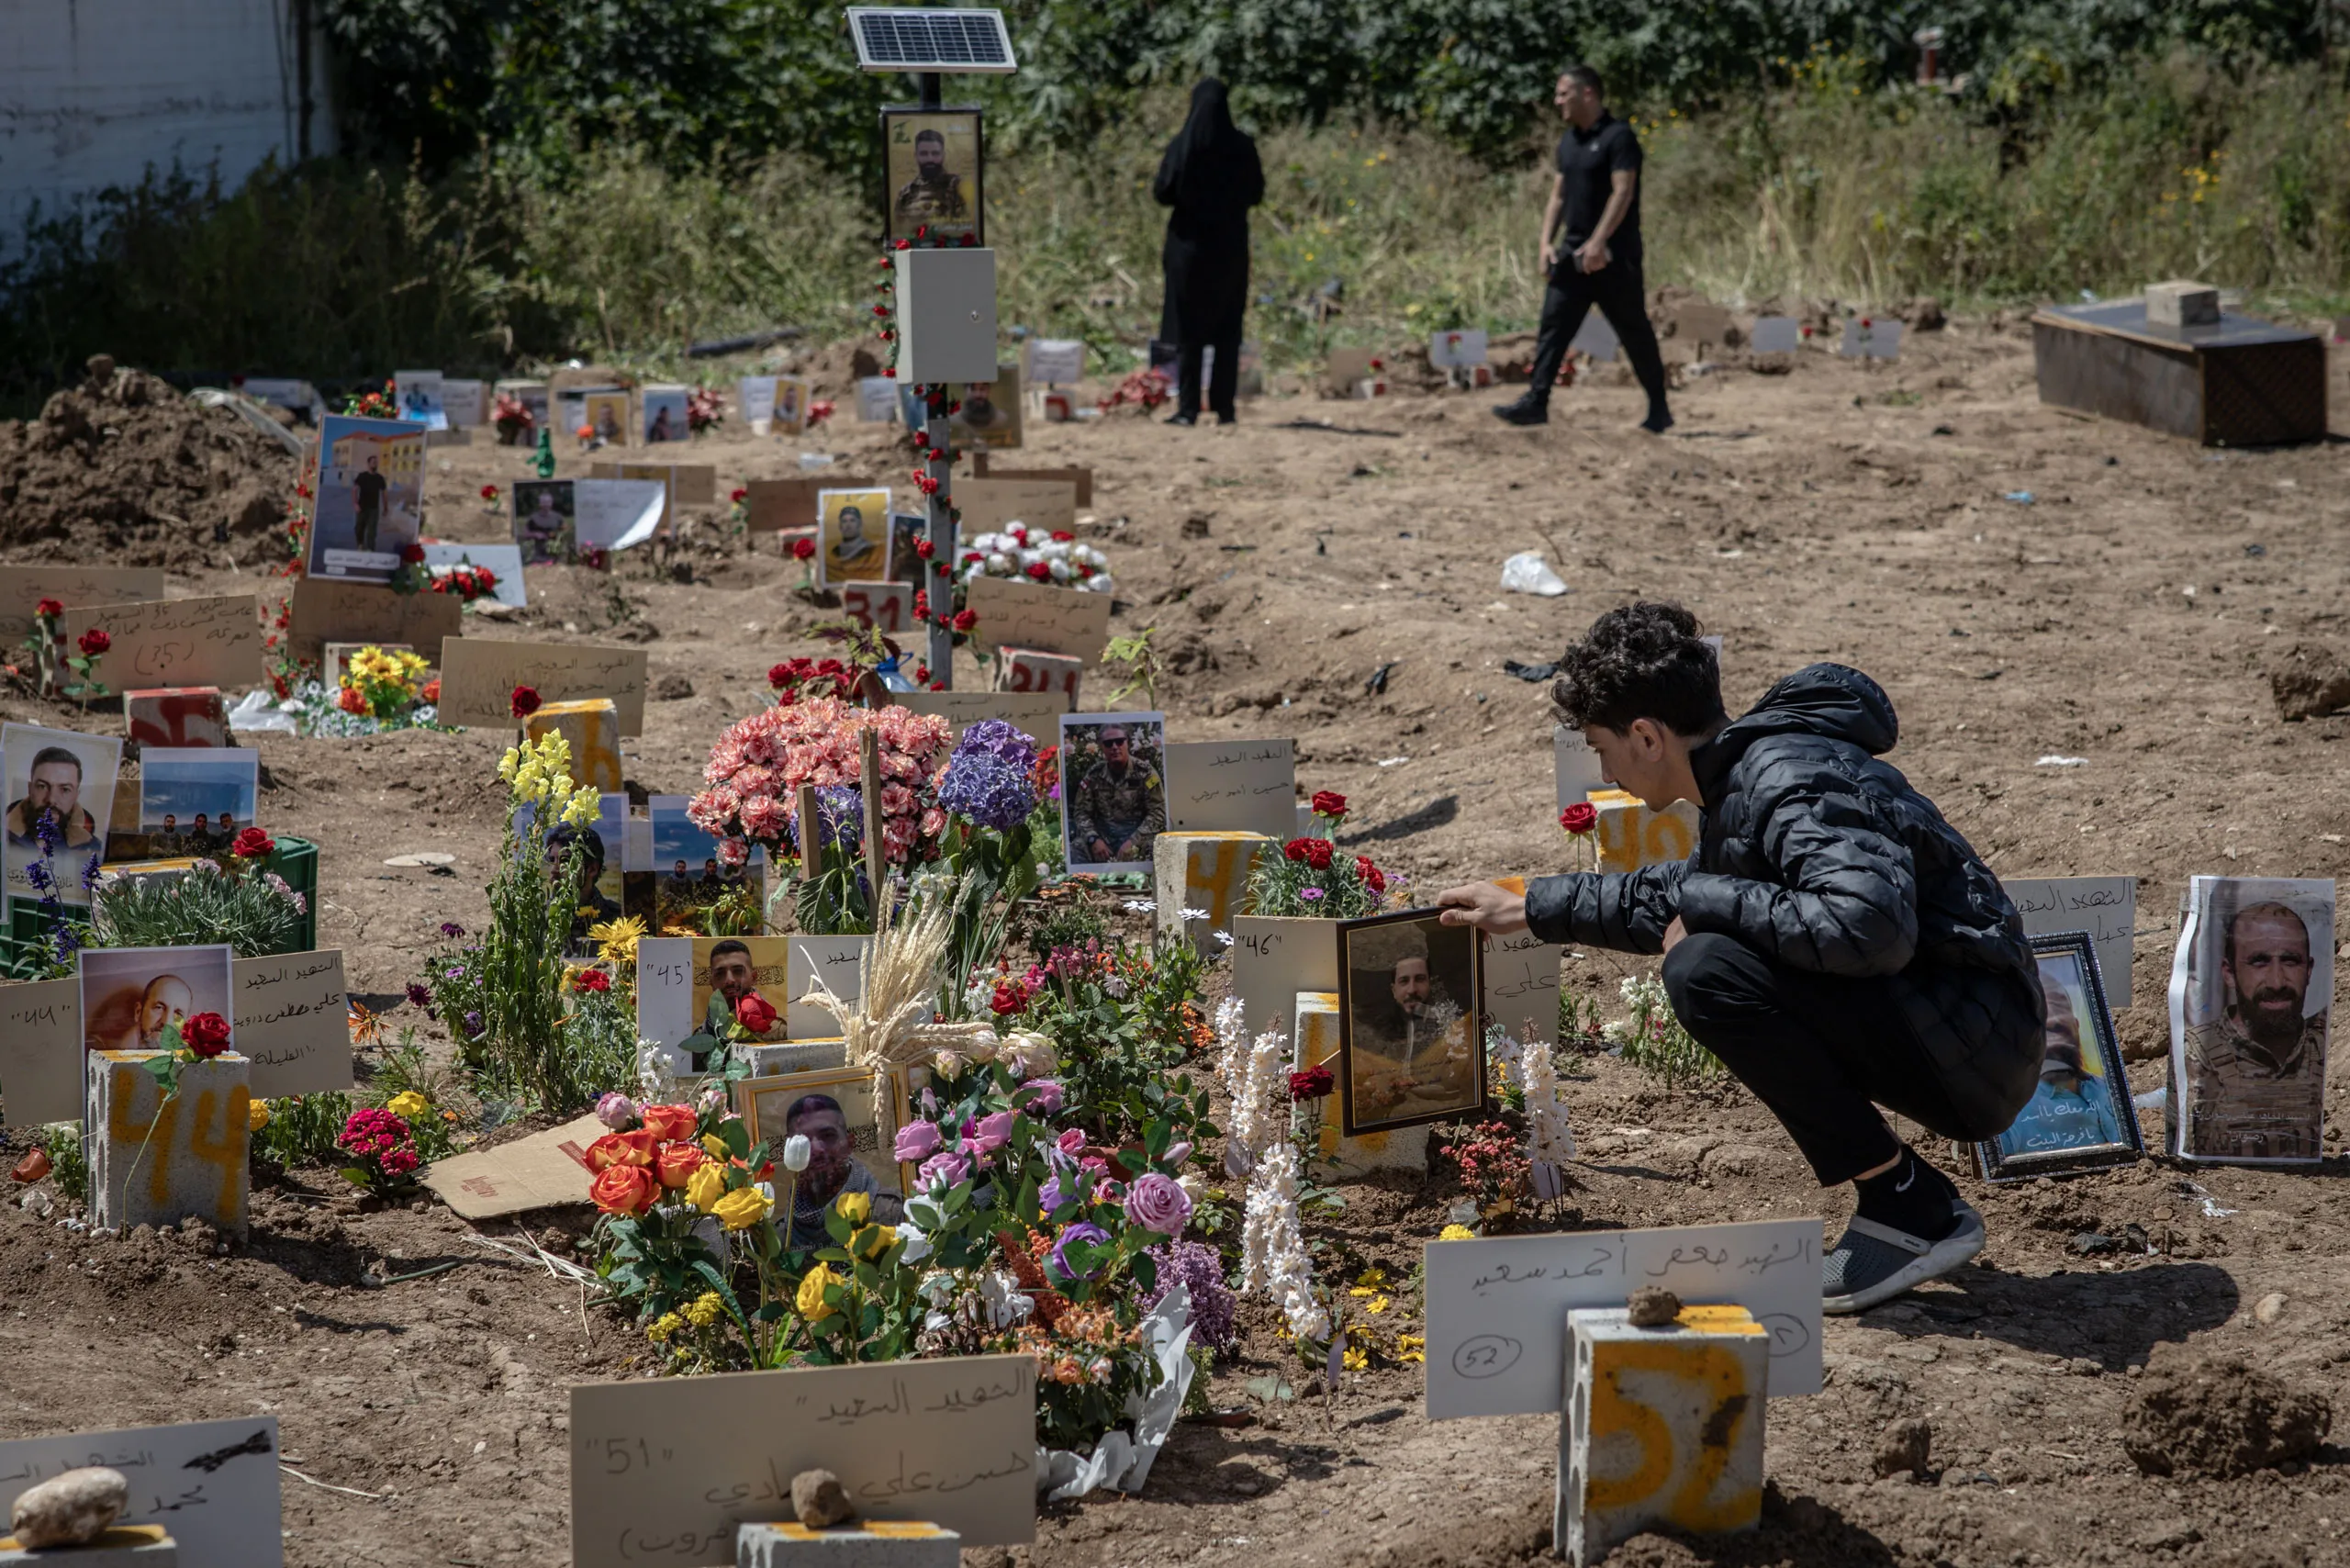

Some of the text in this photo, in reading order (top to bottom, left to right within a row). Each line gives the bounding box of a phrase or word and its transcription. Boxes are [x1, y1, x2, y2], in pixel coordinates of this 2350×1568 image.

[2068, 877, 2132, 911] الشهيد
[826, 947, 862, 965] لسعيد
[1237, 933, 1282, 958] "46"
[1502, 936, 1546, 953] شهيد
[295, 957, 340, 980] الشهيد
[1494, 961, 1557, 999] علي
[313, 992, 341, 1014] علي
[110, 1068, 251, 1225] 44
[2026, 1131, 2061, 1149] البيت
[1471, 1263, 1547, 1297] سعيد
[1463, 1345, 1498, 1369] 52
[586, 1437, 673, 1475] "51"
[935, 1450, 1030, 1474] حسن
[858, 1450, 933, 1506] علي
